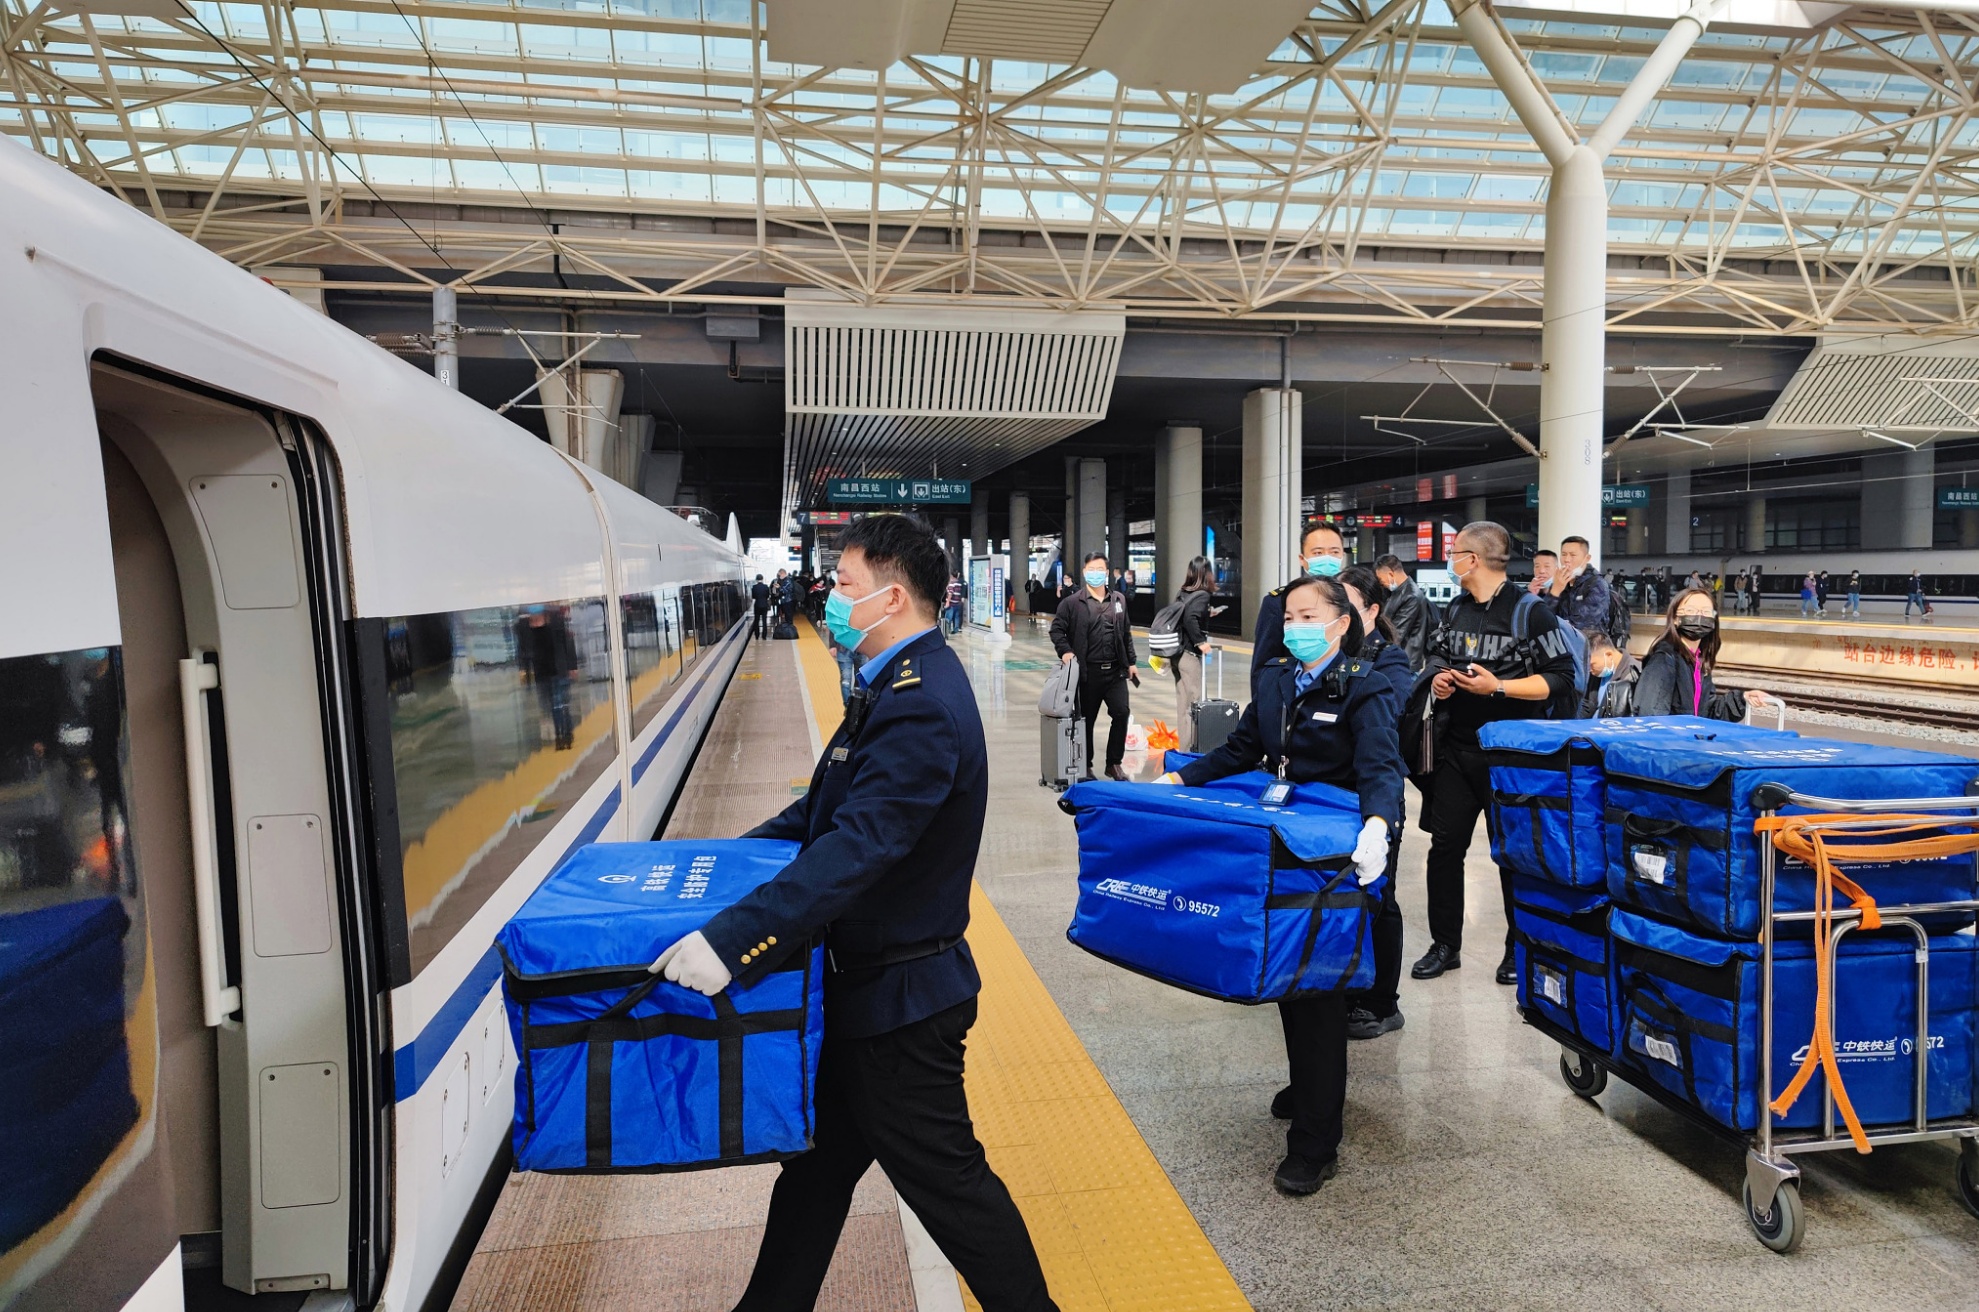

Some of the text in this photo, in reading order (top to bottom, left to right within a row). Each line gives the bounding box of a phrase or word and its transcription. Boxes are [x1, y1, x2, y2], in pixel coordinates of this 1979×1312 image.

[840, 483, 880, 493] 南昌西站
[800, 513, 806, 523] 7
[1395, 516, 1402, 526] 4
[1692, 517, 1699, 526] 2
[1188, 900, 1220, 917] 95572
[1843, 1039, 1896, 1052] 中铁快运
